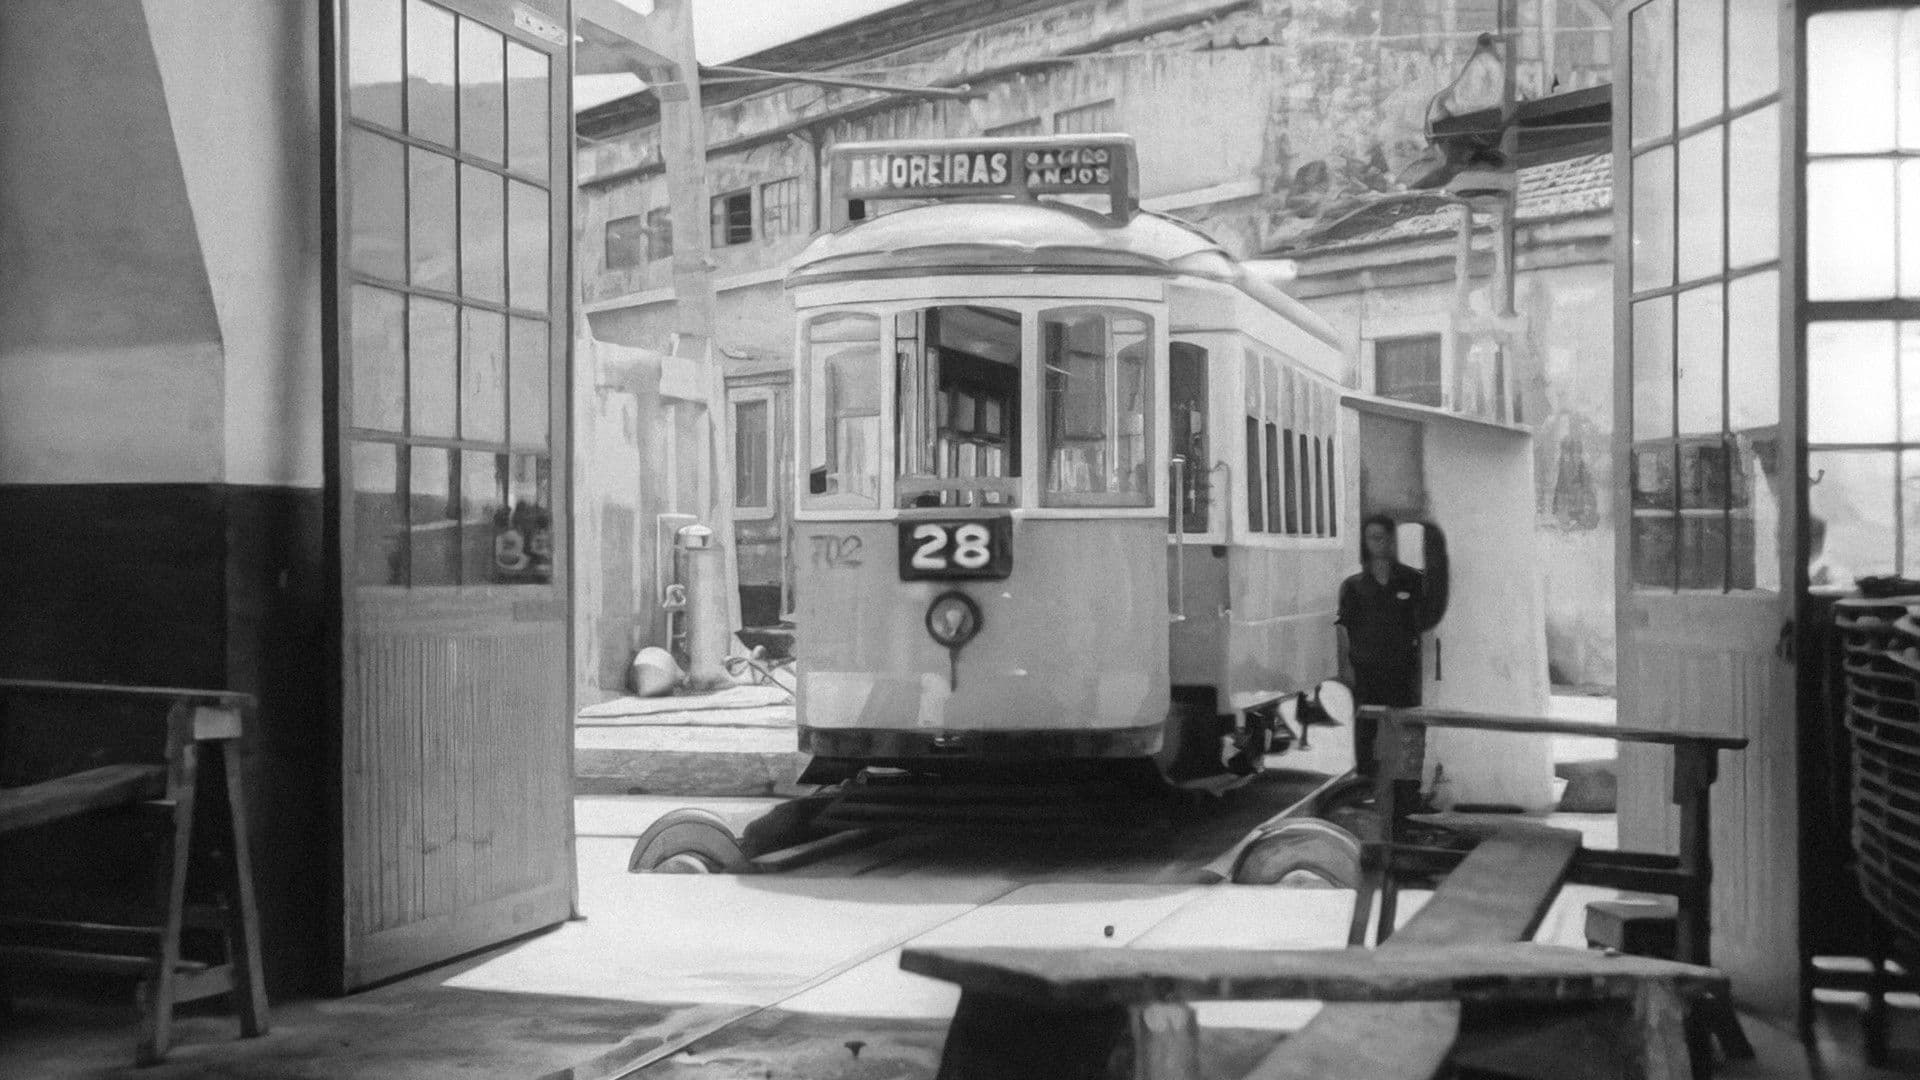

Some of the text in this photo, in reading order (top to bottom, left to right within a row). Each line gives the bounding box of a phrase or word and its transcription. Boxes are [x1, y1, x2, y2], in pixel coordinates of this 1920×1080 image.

[1027, 167, 1110, 187] ANJOS
[809, 534, 863, 568] 702
[911, 523, 991, 569] 28
